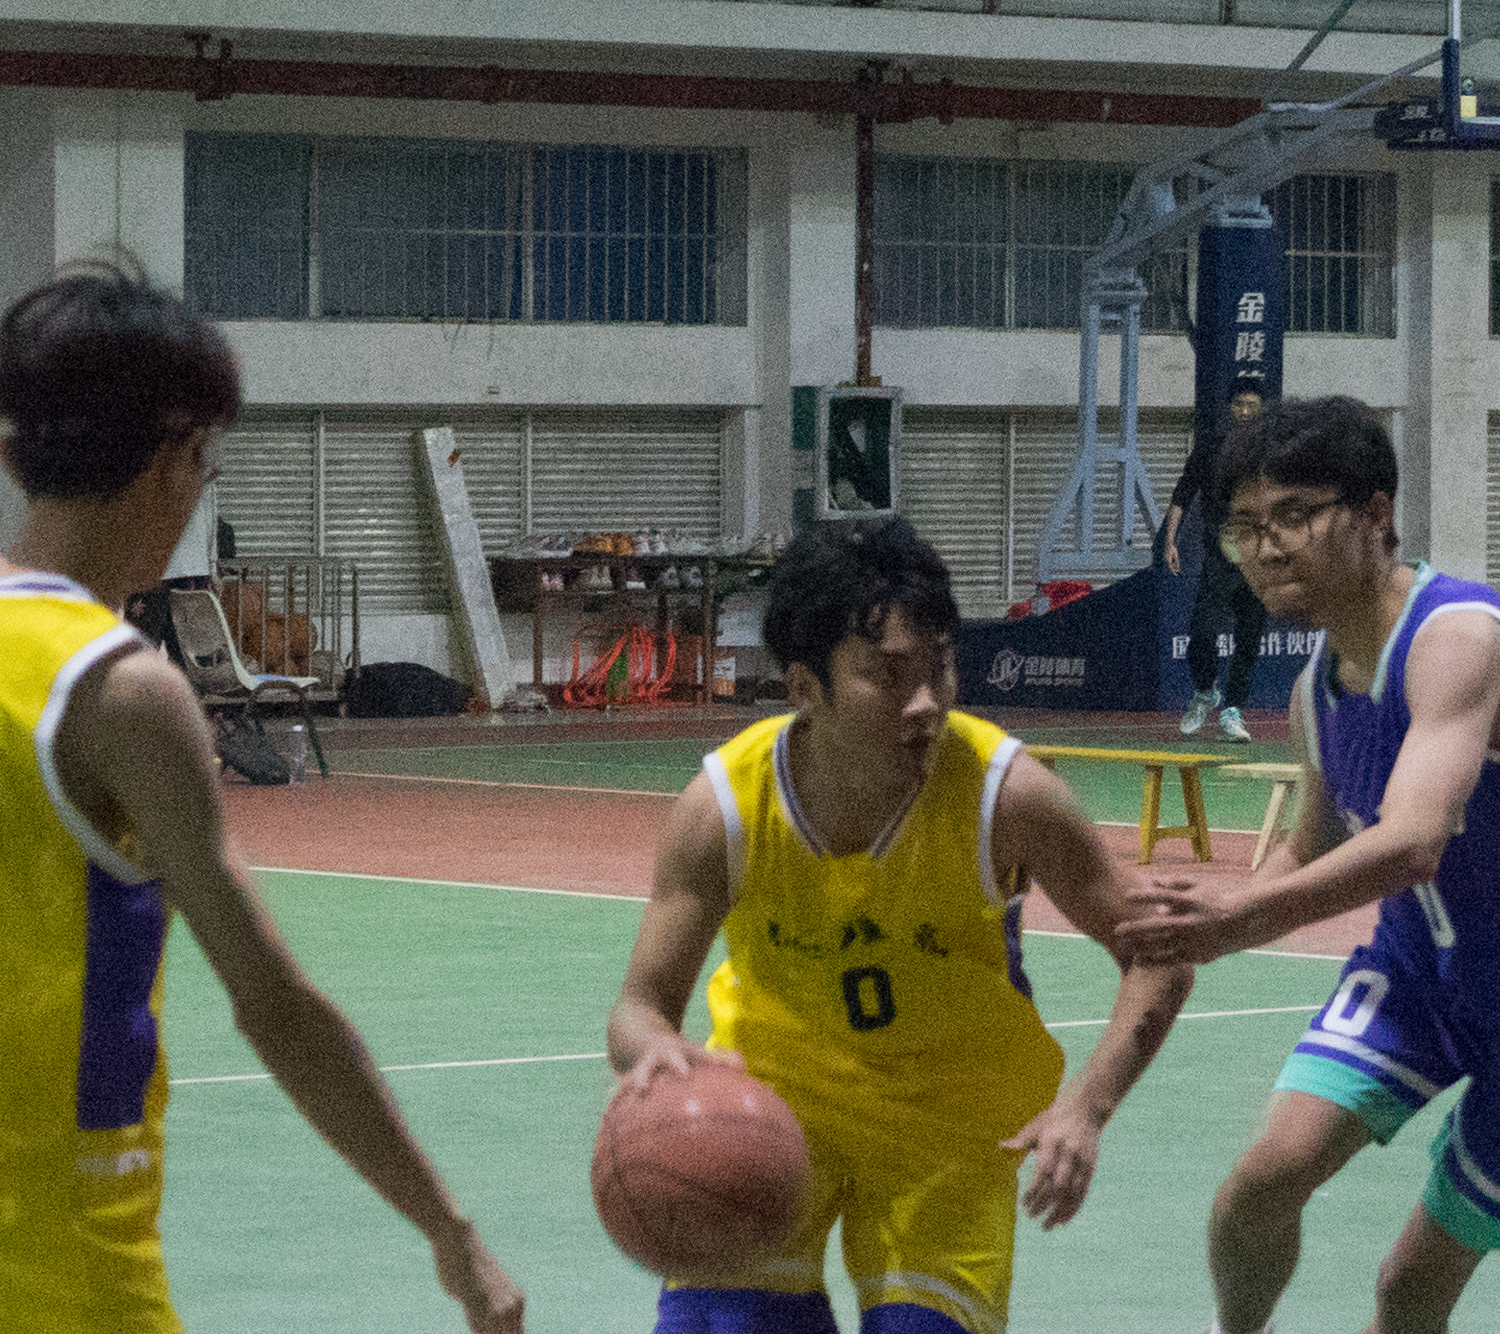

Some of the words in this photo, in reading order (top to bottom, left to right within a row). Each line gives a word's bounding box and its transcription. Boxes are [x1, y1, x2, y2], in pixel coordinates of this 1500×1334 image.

[1235, 291, 1265, 378] 金陵
[842, 966, 897, 1031] 0
[1321, 968, 1391, 1038] 0
